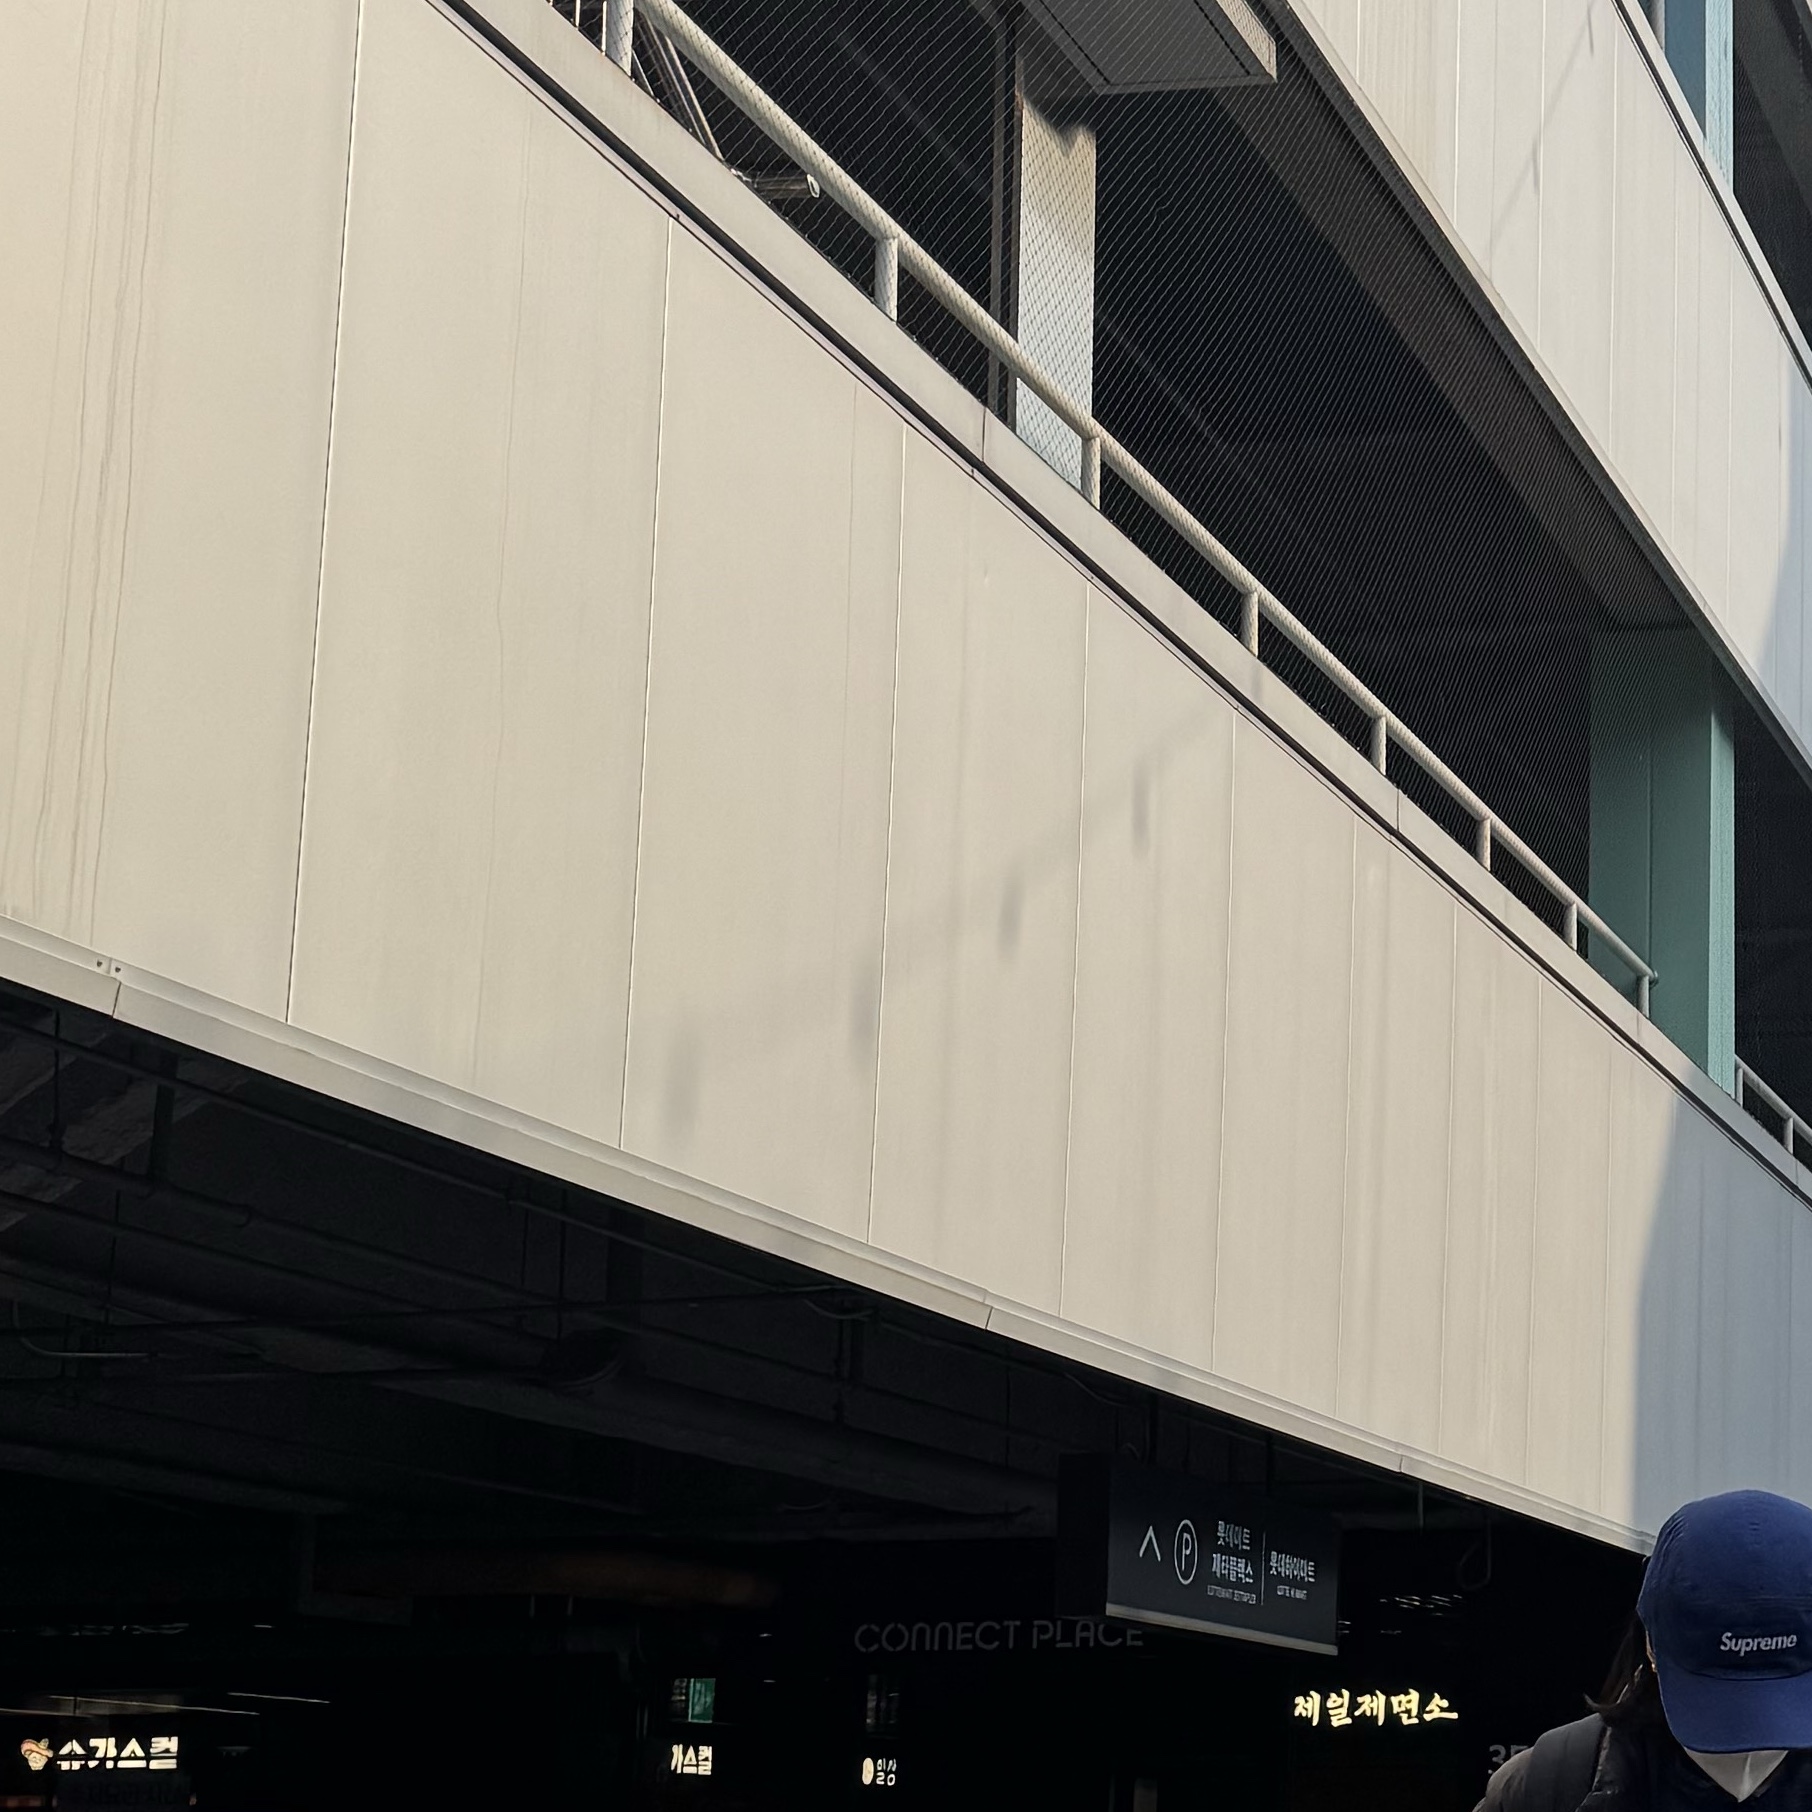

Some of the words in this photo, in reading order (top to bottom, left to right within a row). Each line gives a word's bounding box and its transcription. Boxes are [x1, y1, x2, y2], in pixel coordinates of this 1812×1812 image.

[1217, 1520, 1251, 1550] 롯데마트
[853, 1620, 1022, 1653] CONNECT
[1031, 1618, 1145, 1650] PLACE
[1720, 1631, 1798, 1657] Supreme
[1293, 1688, 1460, 1728] 제일제면소
[56, 1735, 179, 1771] 슈가스컬
